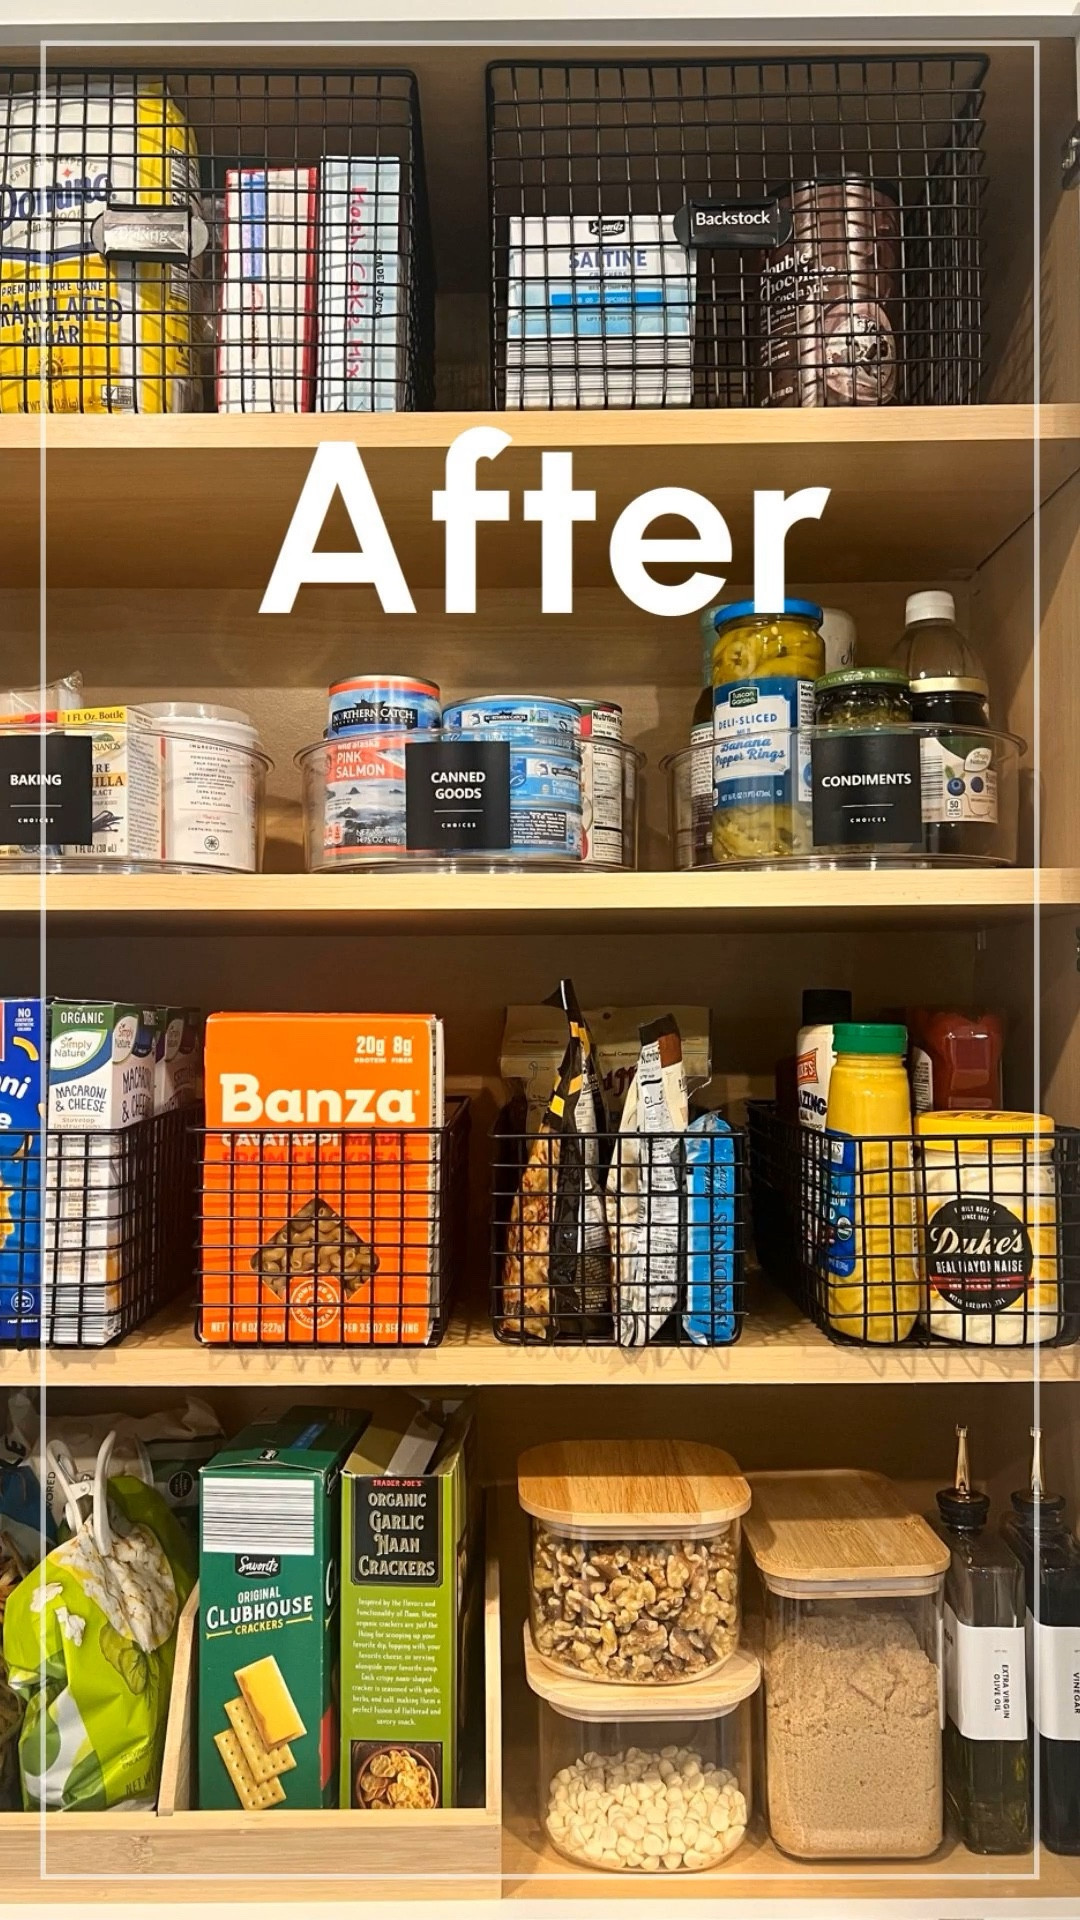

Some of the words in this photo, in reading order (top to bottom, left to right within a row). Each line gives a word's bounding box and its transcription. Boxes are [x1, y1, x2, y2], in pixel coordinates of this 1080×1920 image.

[695, 210, 771, 226] Backstock
[2, 282, 41, 296] PREMUM
[0, 297, 122, 327] RANULATED
[99, 710, 124, 720] Bottle
[380, 708, 414, 719] CATCH
[718, 713, 778, 730] DELI-SLICED
[720, 737, 772, 753] Banana
[336, 751, 362, 765] PINK
[746, 748, 786, 763] Rings
[336, 765, 385, 779] SALMON
[430, 771, 486, 784] CANNED
[10, 774, 62, 787] BAKING
[821, 773, 912, 787] CONDIMENTS
[435, 787, 482, 800] GOODS
[441, 821, 477, 829] CHOICES
[850, 816, 886, 824] CHOICES
[17, 1008, 31, 1018] NO
[60, 1011, 104, 1024] ORGANIC
[60, 1038, 92, 1050] Simply
[356, 1035, 385, 1057] 20g
[392, 1035, 413, 1057] 8g
[54, 1048, 86, 1058] Nature
[55, 1085, 107, 1101] MACARONI
[219, 1072, 416, 1123] Banza
[55, 1102, 65, 1113] &
[68, 1098, 107, 1113] CHEESE
[929, 1227, 1024, 1256] Duke's
[958, 1259, 1023, 1274] MAYONAISE
[385, 1321, 420, 1334] SERING
[372, 1479, 400, 1487] TRADER
[402, 1479, 422, 1487] JOE'S
[368, 1493, 427, 1508] ORGANIC
[368, 1510, 424, 1532] GARLIC
[373, 1532, 420, 1556] NAAN
[238, 1556, 279, 1573] Savoritz
[358, 1554, 436, 1577] CRACKERS
[237, 1586, 281, 1604] ORIGINAL
[206, 1595, 313, 1629] CLUBHOUSE
[234, 1620, 284, 1636] CRACKERS
[1001, 1664, 1009, 1688] EXTRA
[993, 1674, 1001, 1696] OLIVE
[994, 1698, 1002, 1712] OIL
